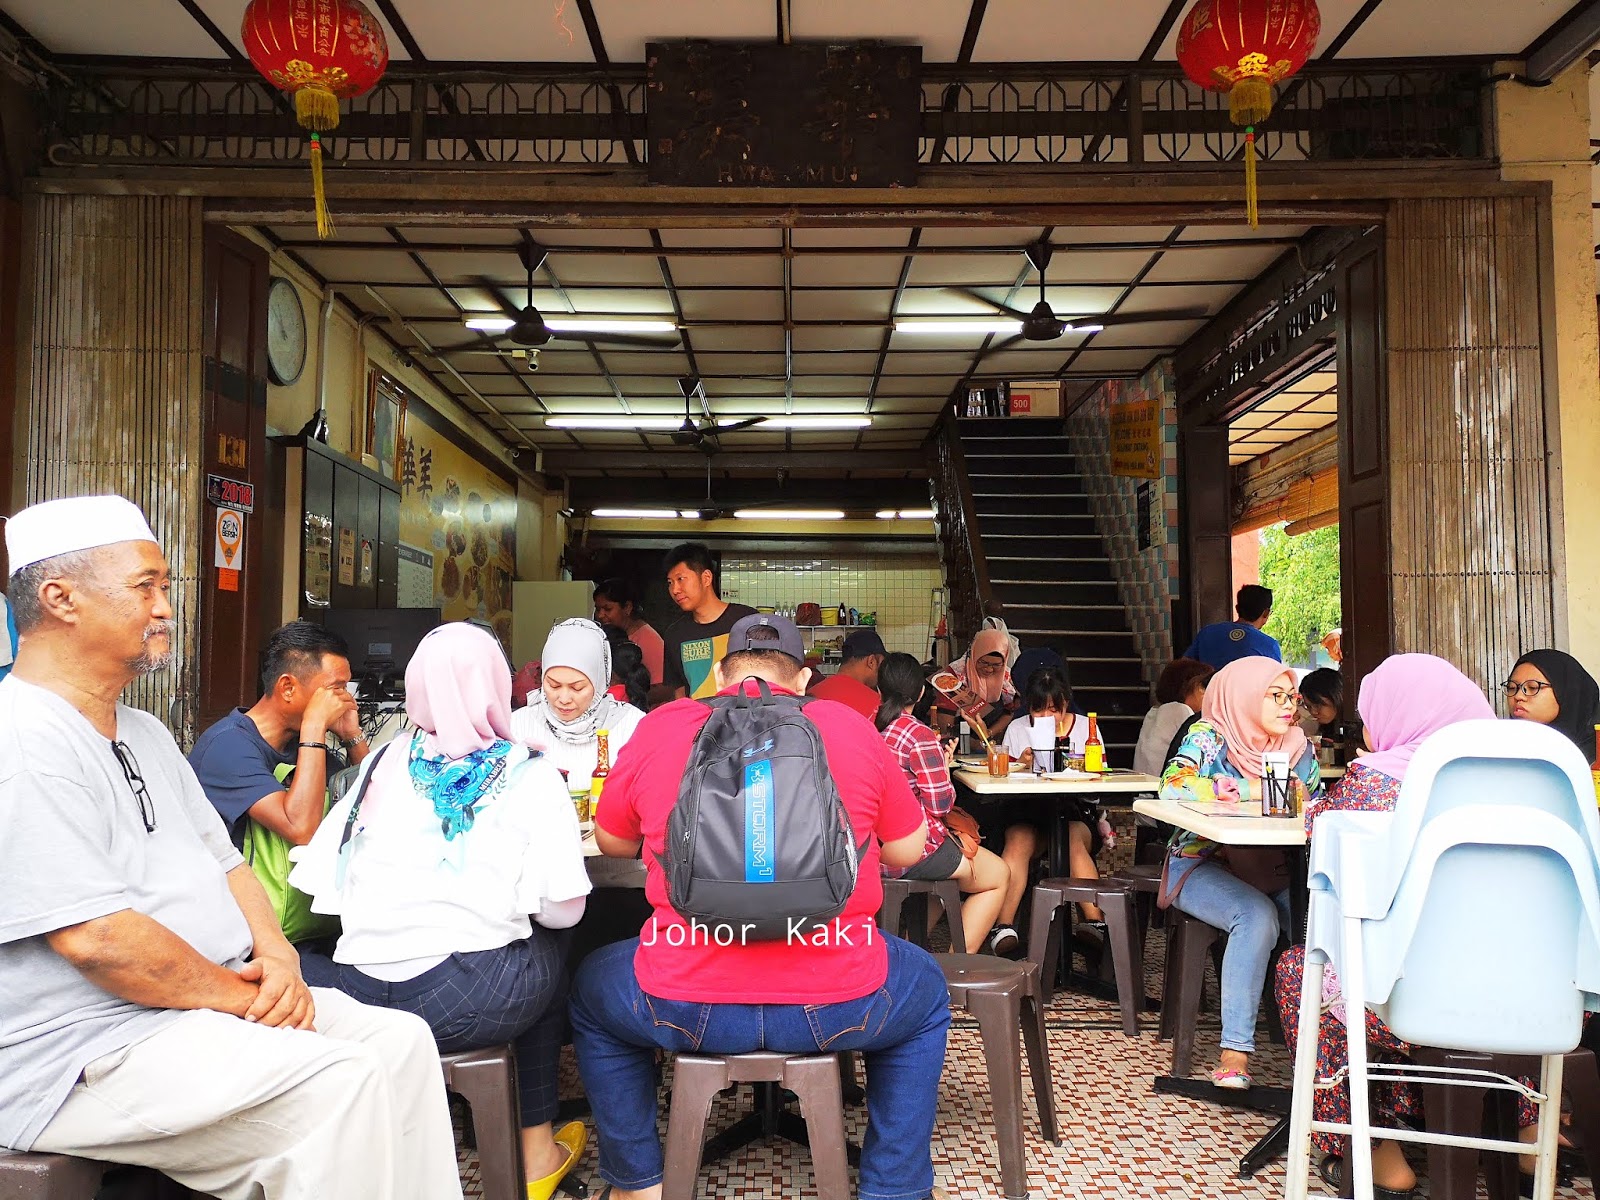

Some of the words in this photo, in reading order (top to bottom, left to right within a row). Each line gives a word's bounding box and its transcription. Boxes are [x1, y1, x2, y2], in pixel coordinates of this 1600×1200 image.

[718, 163, 774, 183] HWA
[1013, 399, 1028, 409] 500
[221, 480, 252, 506] 2018
[682, 640, 711, 651] NIXON
